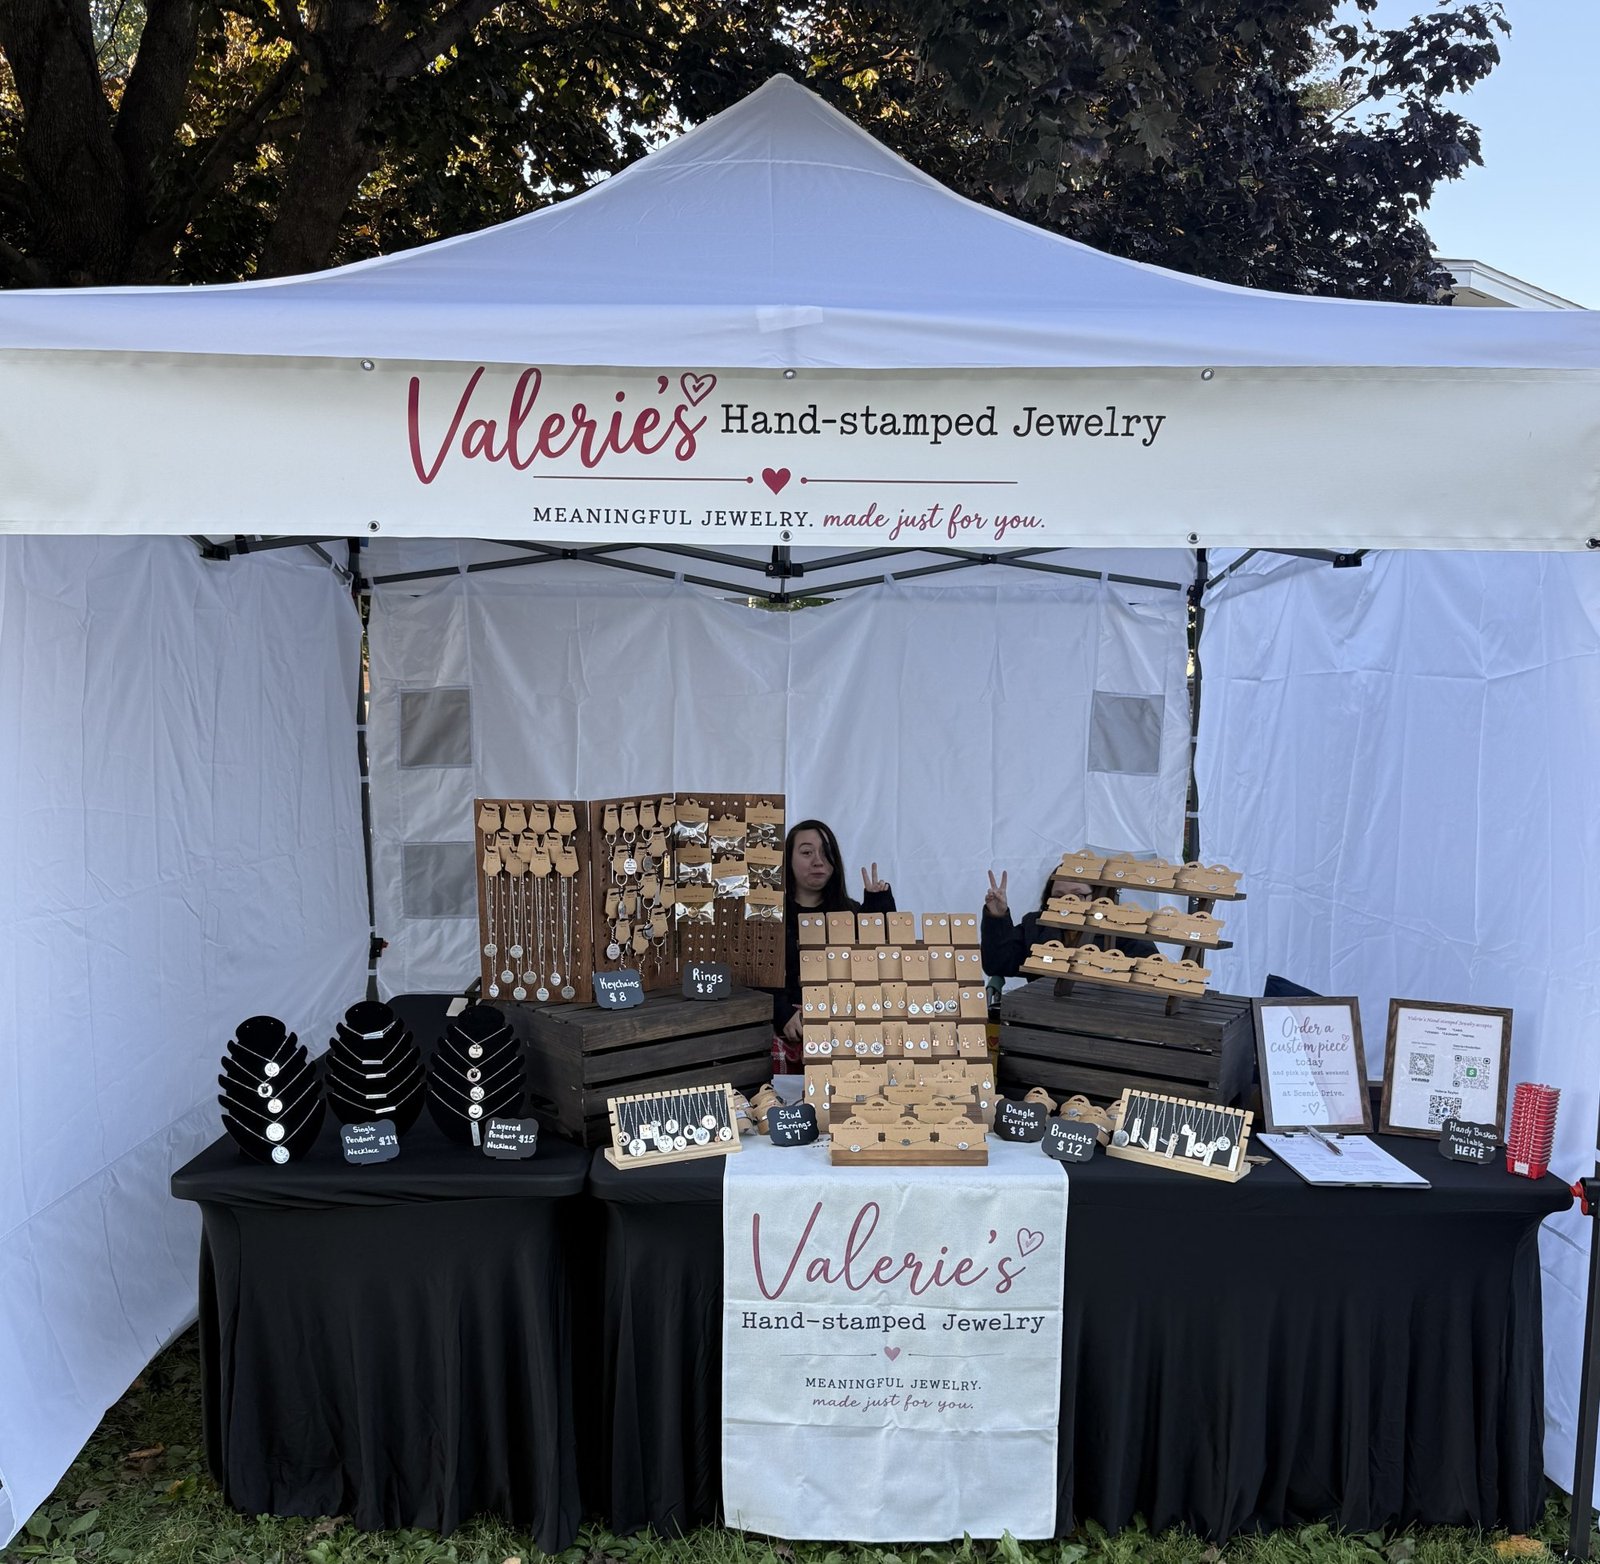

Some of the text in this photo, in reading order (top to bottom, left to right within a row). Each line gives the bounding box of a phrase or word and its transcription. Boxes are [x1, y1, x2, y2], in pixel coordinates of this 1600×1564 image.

[407, 365, 1167, 485] Valerie's Hand-stamped Jewelry
[533, 502, 1046, 541] MEANINGFUL JEWELRY. made just for you.
[692, 967, 723, 985] Rings
[599, 977, 639, 991] Keychains
[1281, 1016, 1335, 1038] Order a
[1270, 1037, 1349, 1058] custom piece
[1296, 1058, 1324, 1068] today
[1286, 1069, 1299, 1077] pick
[1293, 1089, 1319, 1097] Scenic
[1321, 1089, 1345, 1097] Drive.
[779, 1109, 802, 1120] Stud
[1005, 1103, 1035, 1119] Dangle
[491, 1120, 521, 1132] Layered
[776, 1120, 812, 1131] Earrings
[1002, 1114, 1039, 1129] Earrings
[1449, 1121, 1473, 1137] Handy
[352, 1125, 377, 1134] Single
[488, 1130, 536, 1144] Pendant $15
[1050, 1123, 1093, 1145] Bracelets
[345, 1134, 398, 1146] Pendant $14
[486, 1141, 518, 1151] Necklace
[1449, 1134, 1485, 1149] Available
[347, 1147, 380, 1156] Necklace
[1056, 1140, 1083, 1157] $12
[1454, 1143, 1485, 1159] HERE
[752, 1201, 1026, 1300] Valerie's
[741, 1311, 1046, 1334] Hand-stamped Jewelry
[805, 1377, 982, 1391] MEANINGFUL JEWELRY.
[812, 1393, 974, 1413] made just for you.
